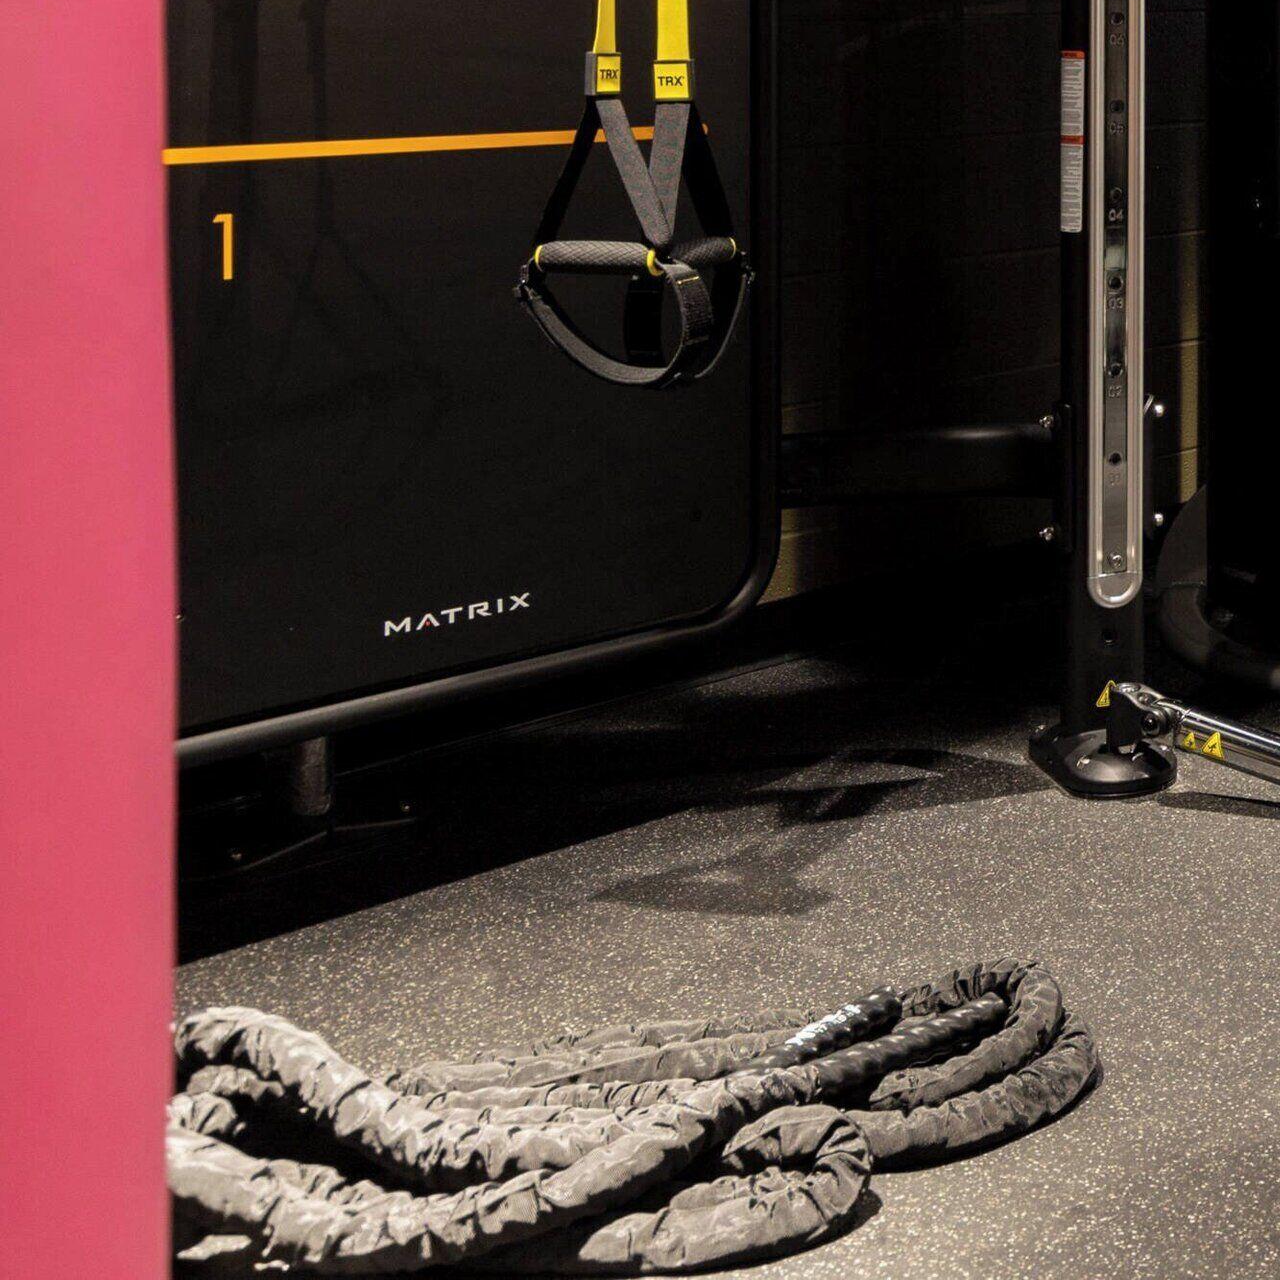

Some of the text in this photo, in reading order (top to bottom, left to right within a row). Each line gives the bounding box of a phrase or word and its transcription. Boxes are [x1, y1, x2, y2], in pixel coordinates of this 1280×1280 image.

[599, 69, 619, 80] TRX
[657, 75, 684, 87] TRX
[1108, 208, 1123, 222] 04
[211, 213, 234, 280] 1
[383, 592, 531, 637] MATRIX
